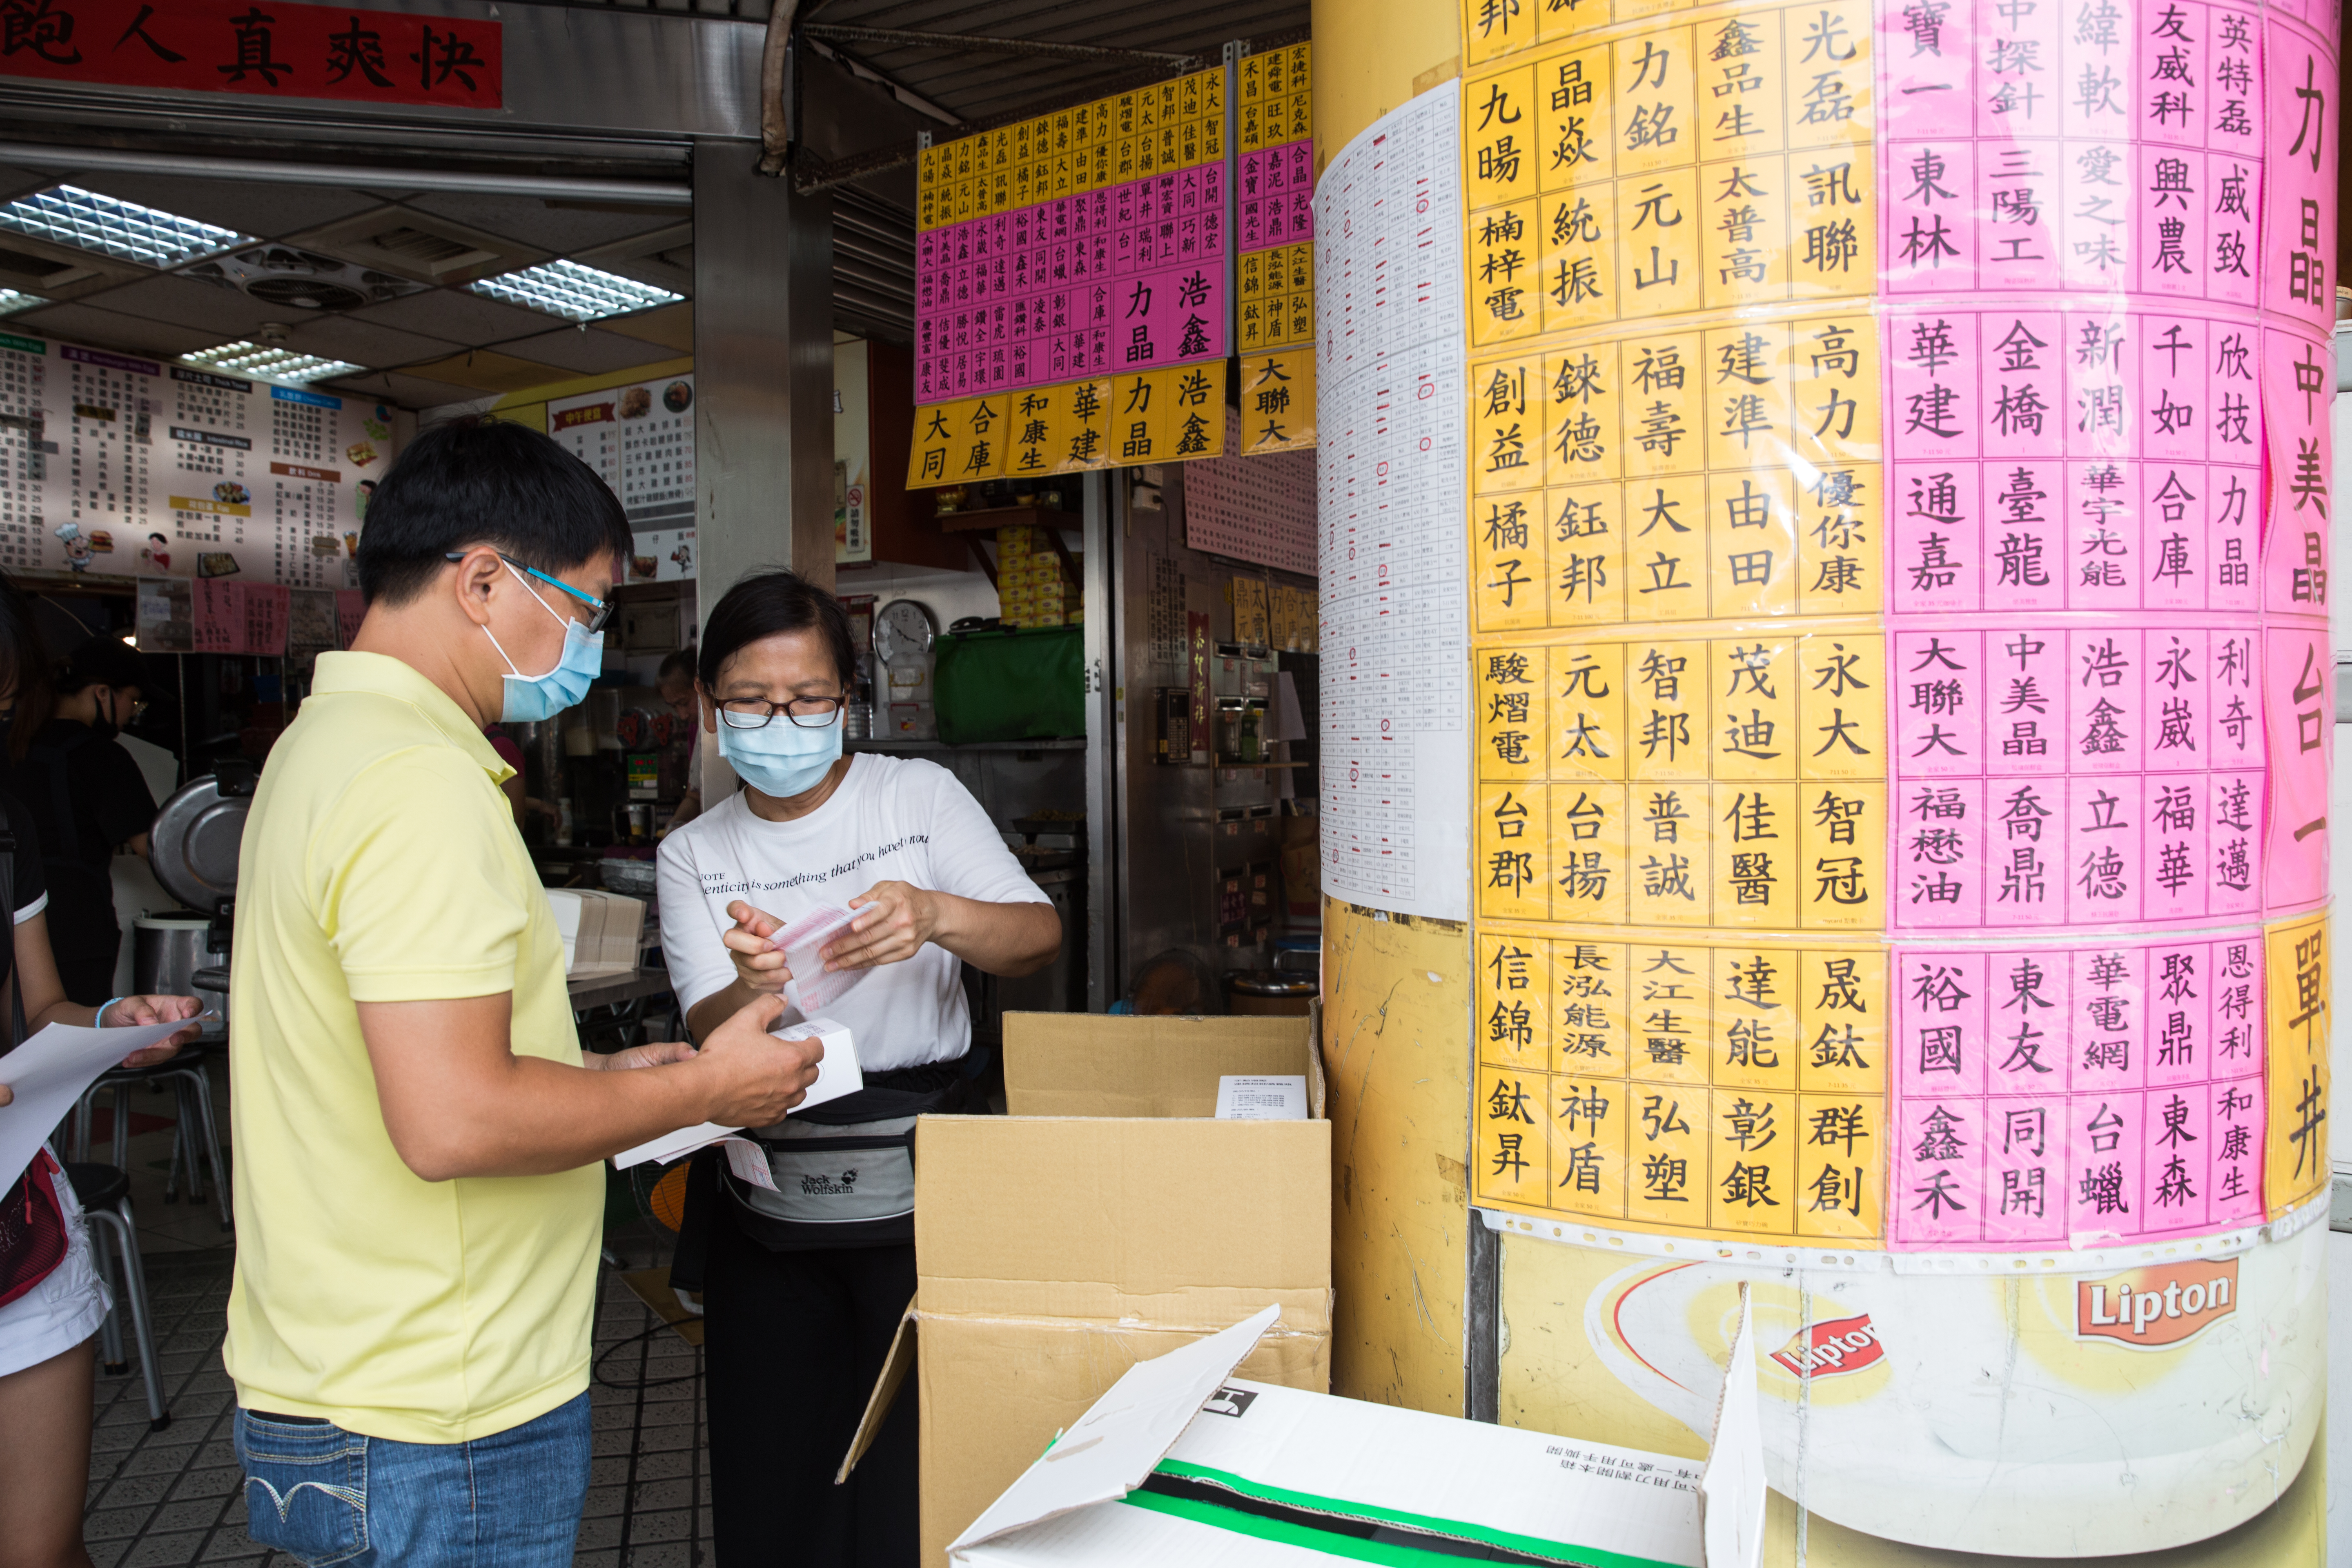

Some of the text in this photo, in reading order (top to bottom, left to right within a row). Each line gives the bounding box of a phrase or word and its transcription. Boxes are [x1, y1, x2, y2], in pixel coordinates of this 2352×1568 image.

[1551, 59, 1598, 171] 晶焱
[1624, 41, 1678, 151] 力銘
[1708, 19, 1765, 142] 鑫品生
[1796, 10, 1857, 126] 光磊
[2073, 0, 2127, 119] 緯軟
[2150, 3, 2194, 128] 友威科
[2214, 14, 2253, 137] 英特磊
[1477, 84, 1521, 183] 九暘
[2289, 53, 2325, 313] 力晶
[1551, 197, 1603, 307] 統振
[1632, 183, 1682, 290] 元山
[1715, 167, 1768, 285] 太普高
[1800, 161, 1861, 272] 訊聯
[1899, 148, 1961, 269] 東林
[1989, 149, 2044, 262] 三陽工
[2073, 145, 2127, 271] 愛之味
[2150, 158, 2194, 275] 興農
[2214, 163, 2251, 278] 威致
[1125, 281, 1154, 363] 力晶
[1177, 270, 1212, 358] 浩鑫
[1478, 211, 1525, 321] 楠梓電
[1017, 393, 1049, 471] 和康生
[1068, 383, 1101, 464] 華建
[1124, 377, 1152, 458] 力晶
[1176, 369, 1212, 456] 浩鑫
[1255, 359, 1292, 446] 大聯大
[1483, 366, 1529, 473] 創益
[1553, 353, 1606, 464] 錸德
[1633, 345, 1686, 457] 福壽
[1717, 332, 1775, 450] 建準
[1810, 324, 1859, 440] 高力
[1905, 318, 1964, 439] 華建
[1991, 319, 2049, 437] 金橋
[2077, 319, 2126, 436] 新潤
[2152, 324, 2193, 435] 千如
[2216, 332, 2252, 445] 欣技
[921, 410, 951, 480] 大同
[963, 400, 998, 477] 合庫
[2290, 343, 2328, 606] 中美晶
[1483, 501, 1531, 608] 橘子
[1556, 497, 1608, 604] 鈺邦
[1637, 488, 1692, 594] 大立
[1726, 480, 1773, 586] 由田
[1807, 469, 1866, 594] 優你康
[1906, 472, 1966, 591] 通嘉
[1993, 467, 2049, 587] 臺龍
[2079, 465, 2128, 587] 華宇光能
[2152, 470, 2196, 588] 合庫
[2217, 474, 2249, 587] 力晶
[1486, 652, 1535, 764] 駿熠電
[1561, 654, 1610, 759] 元太
[1638, 649, 1690, 762] 智邦
[1723, 644, 1781, 760] 茂迪
[1813, 643, 1870, 757] 永大
[1909, 637, 1967, 758] 大聯大
[2000, 633, 2049, 756] 中美晶
[2079, 637, 2129, 755] 浩鑫
[2154, 636, 2197, 751] 永崴
[2217, 637, 2252, 751] 利奇
[2293, 641, 2327, 844] 台一
[752, 879, 761, 889] is
[763, 872, 826, 891] something
[831, 860, 856, 878] that
[858, 853, 875, 870] you
[1488, 791, 1533, 898] 台郡
[1559, 791, 1611, 901] 台揚
[1639, 791, 1695, 901] 普誠
[1723, 792, 1779, 906] 佳醫
[1813, 790, 1869, 904] 智冠
[1909, 786, 1966, 903] 福懋油
[1997, 785, 2053, 903] 喬鼎
[2077, 788, 2129, 900] 立德
[2152, 785, 2194, 898] 福華
[2216, 778, 2252, 891] 達邁
[1488, 944, 1533, 1052] 信錦
[1563, 945, 1612, 1058] 長泓能源
[1643, 950, 1695, 1065] 大江生醫
[1725, 955, 1782, 1068] 達能
[1810, 958, 1869, 1069] 晟鈦
[1912, 963, 1972, 1075] 裕國
[1999, 956, 2055, 1073] 東友
[2083, 954, 2130, 1071] 華電網
[2158, 953, 2197, 1067] 聚鼎
[2219, 944, 2254, 1059] 恩得利
[2289, 927, 2327, 1183] 單井
[802, 1174, 830, 1184] Jack
[1488, 1079, 1535, 1183] 鈦昇
[1559, 1085, 1609, 1195] 神盾
[1642, 1095, 1690, 1203] 弘塑
[1720, 1098, 1780, 1208] 彰銀
[1808, 1103, 1869, 1217] 群創
[1911, 1105, 1967, 1220] 鑫禾
[2000, 1106, 2047, 1218] 同開
[2078, 1102, 2129, 1214] 台蠟
[2152, 1094, 2197, 1208] 東森
[2216, 1087, 2252, 1201] 和康生
[802, 1184, 854, 1195] Wolfskin
[2091, 1275, 2231, 1334] Lipton
